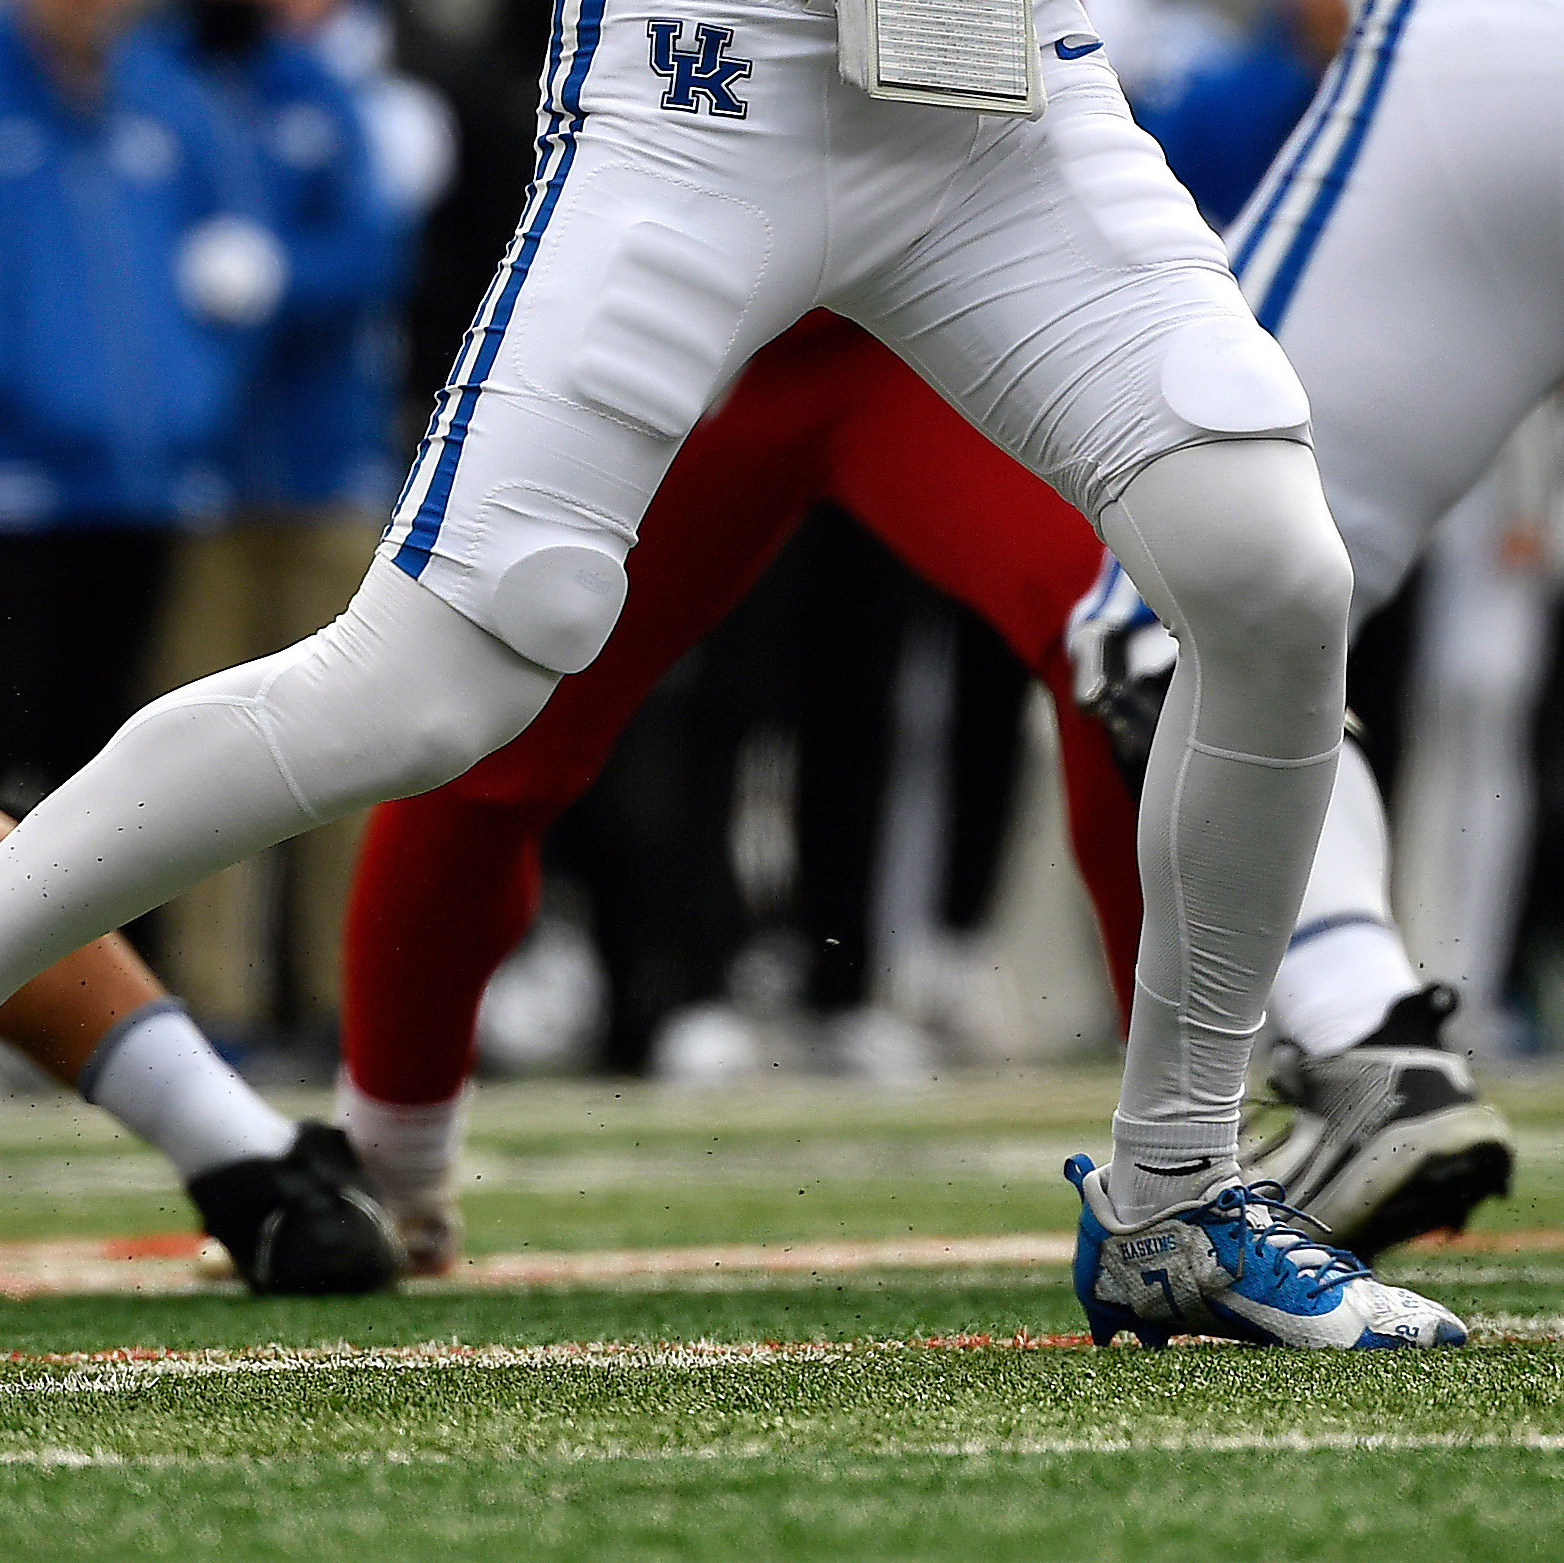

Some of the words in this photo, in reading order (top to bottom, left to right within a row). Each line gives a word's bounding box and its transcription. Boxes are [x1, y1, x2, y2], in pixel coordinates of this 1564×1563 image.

[645, 18, 754, 120] UK
[1120, 1234, 1177, 1261] HASKINS
[1140, 1268, 1182, 1315] 7
